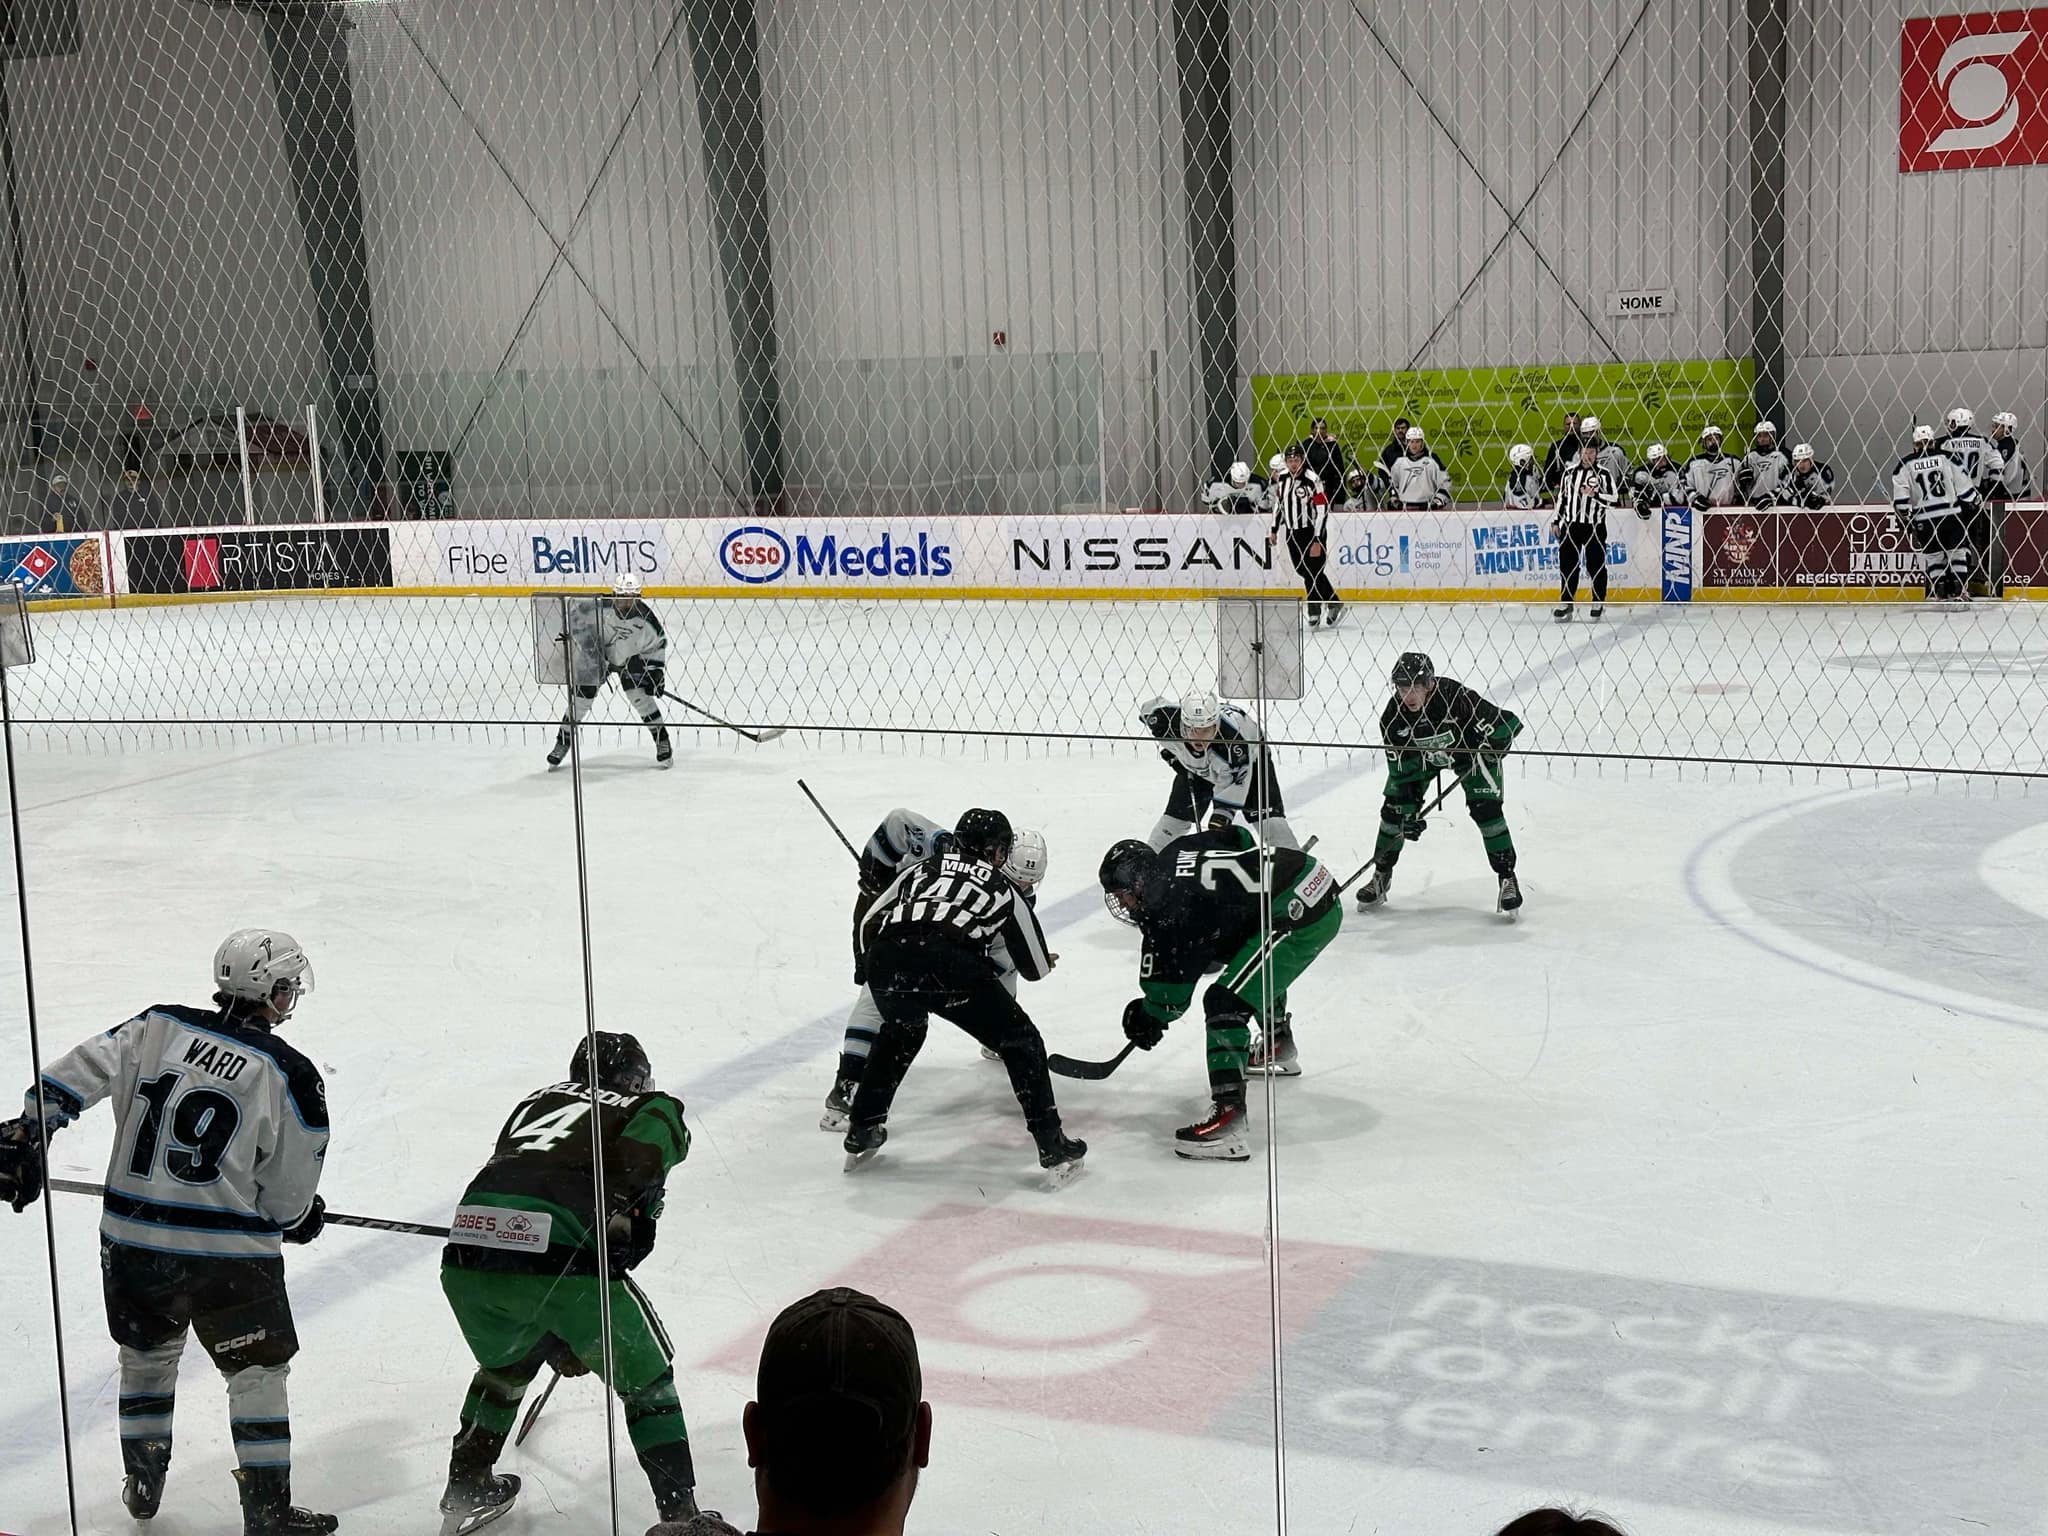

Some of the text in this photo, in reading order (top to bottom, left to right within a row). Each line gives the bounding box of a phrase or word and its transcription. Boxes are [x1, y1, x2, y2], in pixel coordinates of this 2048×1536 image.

[1620, 296, 1663, 310] HOME
[1914, 459, 1939, 471] CULLEN
[1915, 470, 1946, 501] 18
[1472, 524, 1540, 551] WEAR
[188, 540, 339, 587] ARTISTA
[449, 546, 508, 574] Fibe
[731, 532, 953, 576] Esso Medals
[1013, 538, 1272, 570] NISSAN
[1339, 533, 1394, 577] adg
[1414, 550, 1442, 560] Dental
[1414, 560, 1441, 570] Group
[308, 572, 340, 581] HOMES
[1730, 567, 1765, 577] PAUL'S
[1796, 573, 1926, 584] REGISTER TODAY:
[941, 858, 992, 883] MIKO
[1026, 860, 1036, 868] 23
[183, 1038, 249, 1081] WARD
[127, 1072, 243, 1187] 19
[215, 1328, 266, 1354] CCM
[1407, 1279, 1982, 1397] hockey
[1364, 1327, 1583, 1390] for
[1312, 1387, 1834, 1487] centre
